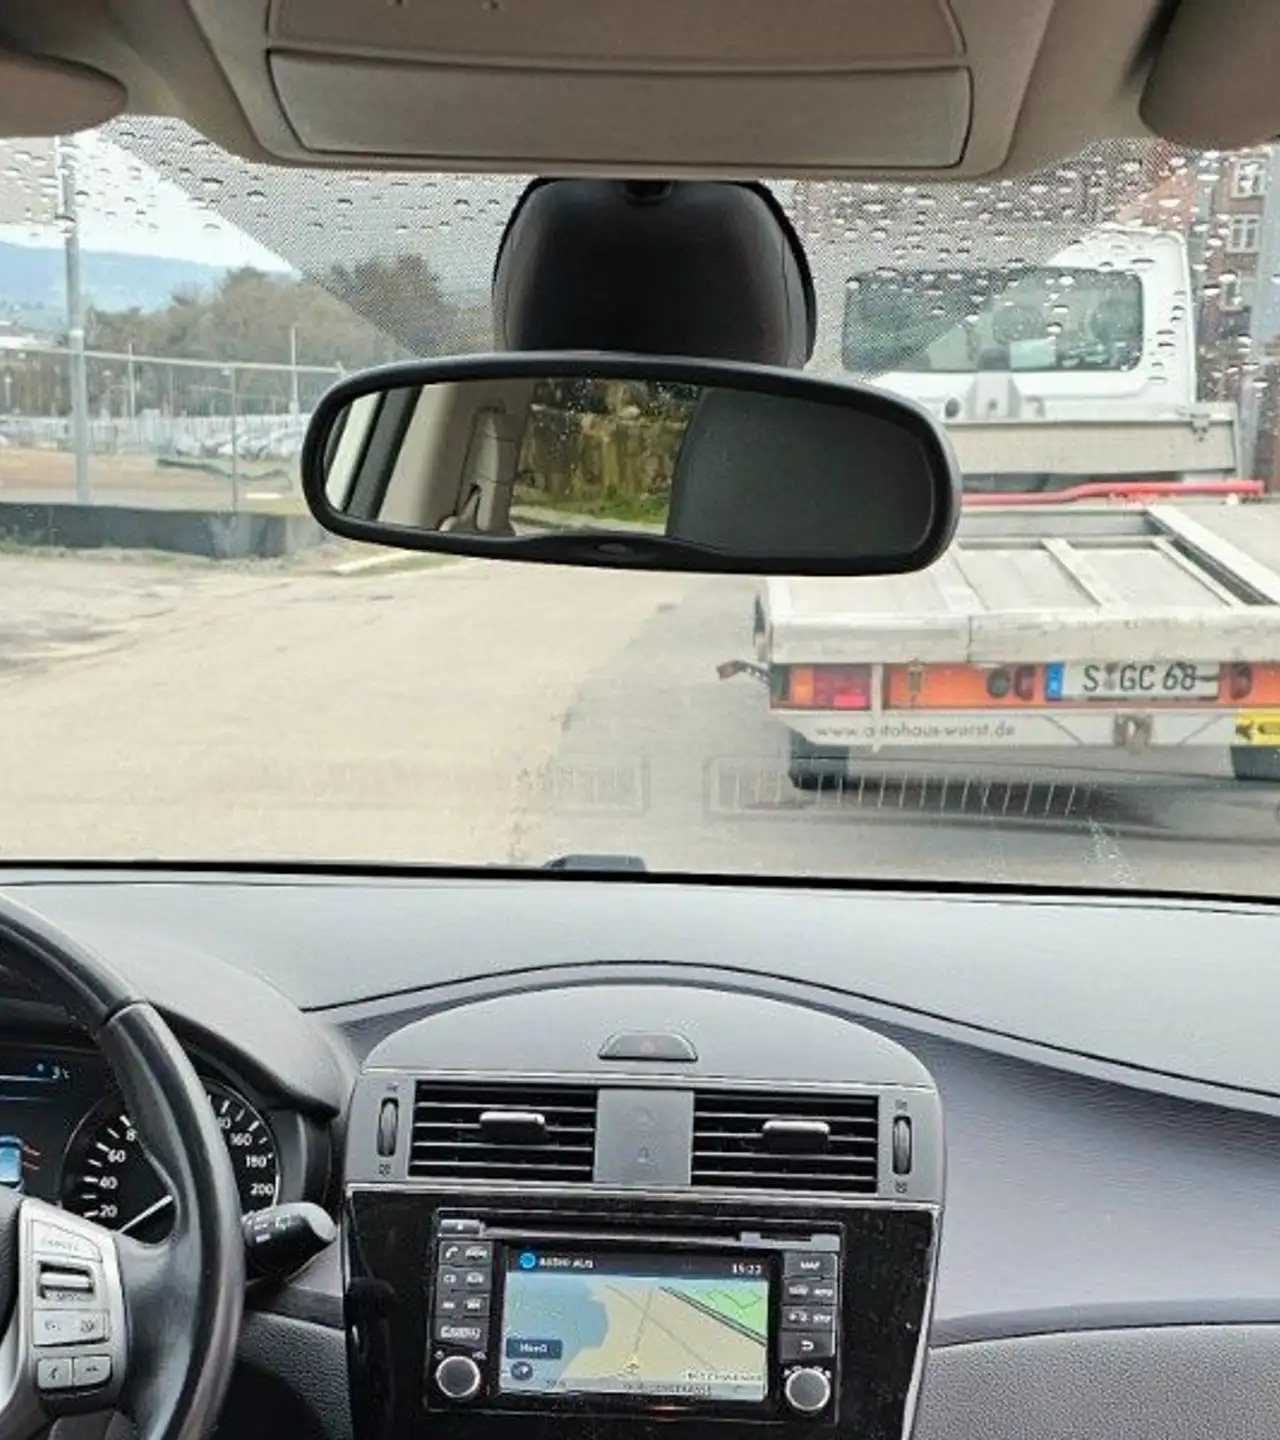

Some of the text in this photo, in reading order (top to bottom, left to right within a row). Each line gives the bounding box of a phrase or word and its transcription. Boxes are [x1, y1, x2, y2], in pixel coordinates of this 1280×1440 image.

[230, 1132, 253, 1147] 160
[107, 1149, 126, 1163] 60
[99, 1175, 118, 1189] 40
[250, 1183, 274, 1196] 200
[99, 1205, 118, 1217] 20
